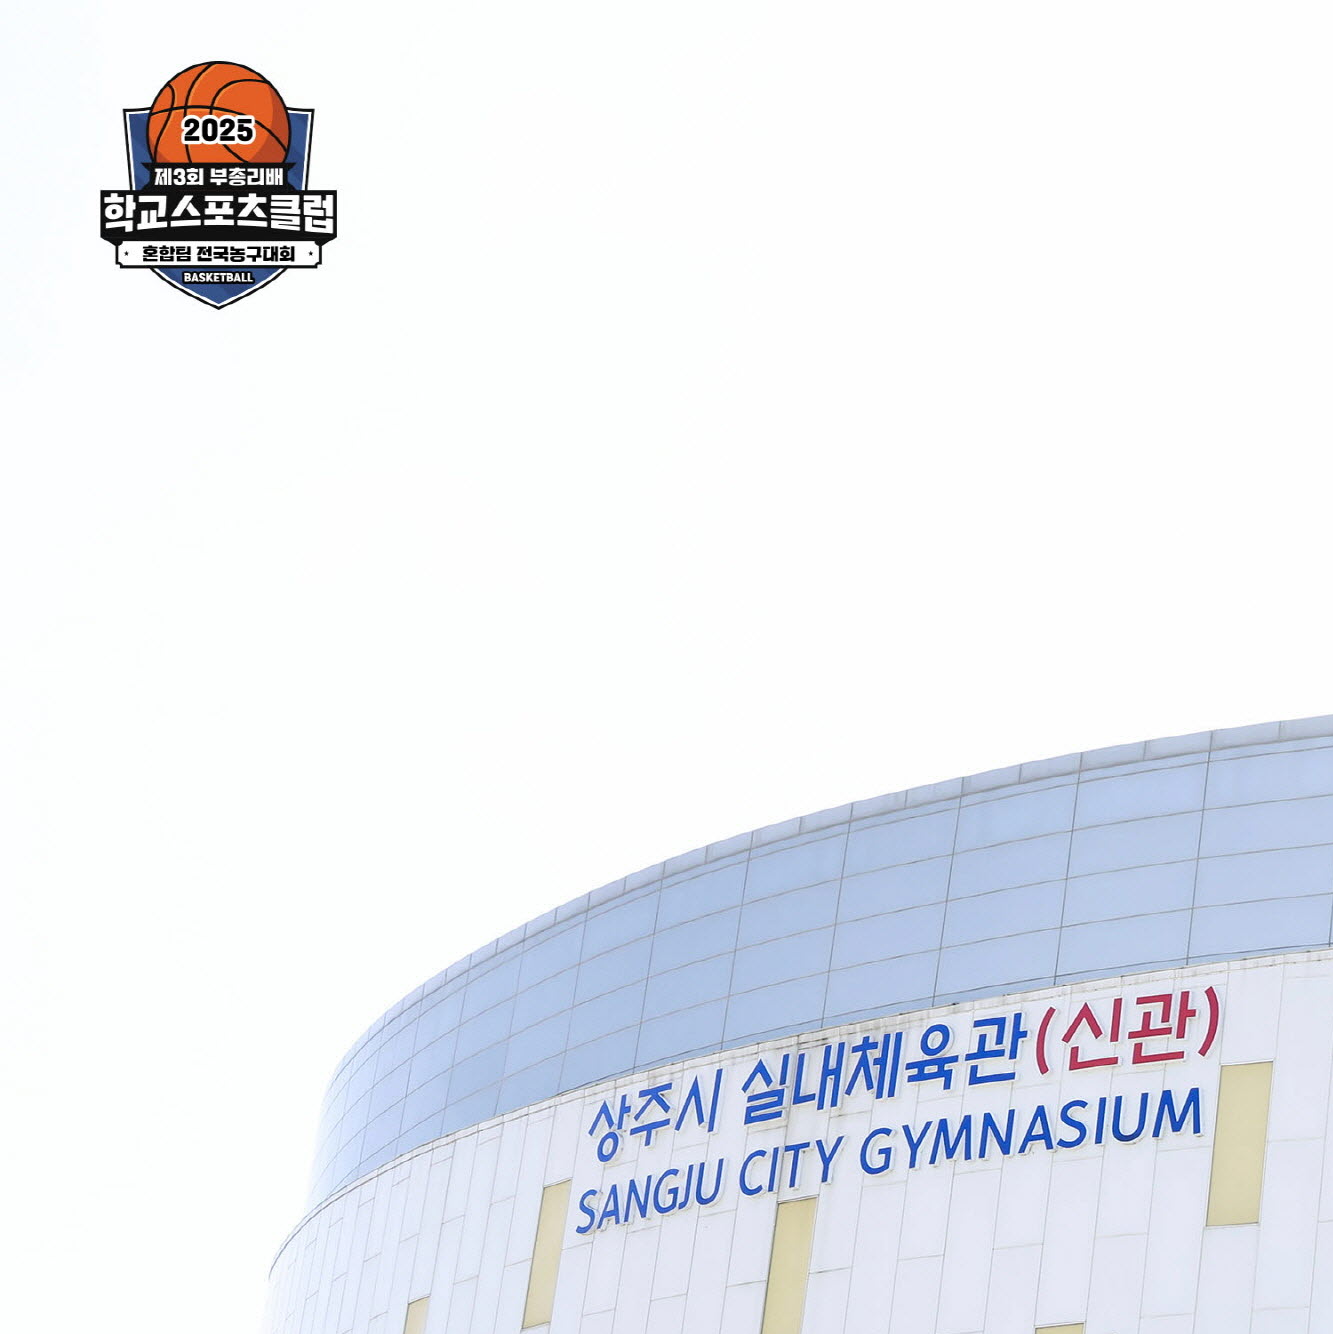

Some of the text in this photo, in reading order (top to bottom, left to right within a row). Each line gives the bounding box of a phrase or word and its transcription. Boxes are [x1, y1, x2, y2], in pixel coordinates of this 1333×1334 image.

[588, 985, 1221, 1163] 상주시 실내체육관(신관)
[575, 1087, 1201, 1235] SANGJU CITY GYMNASIUM
